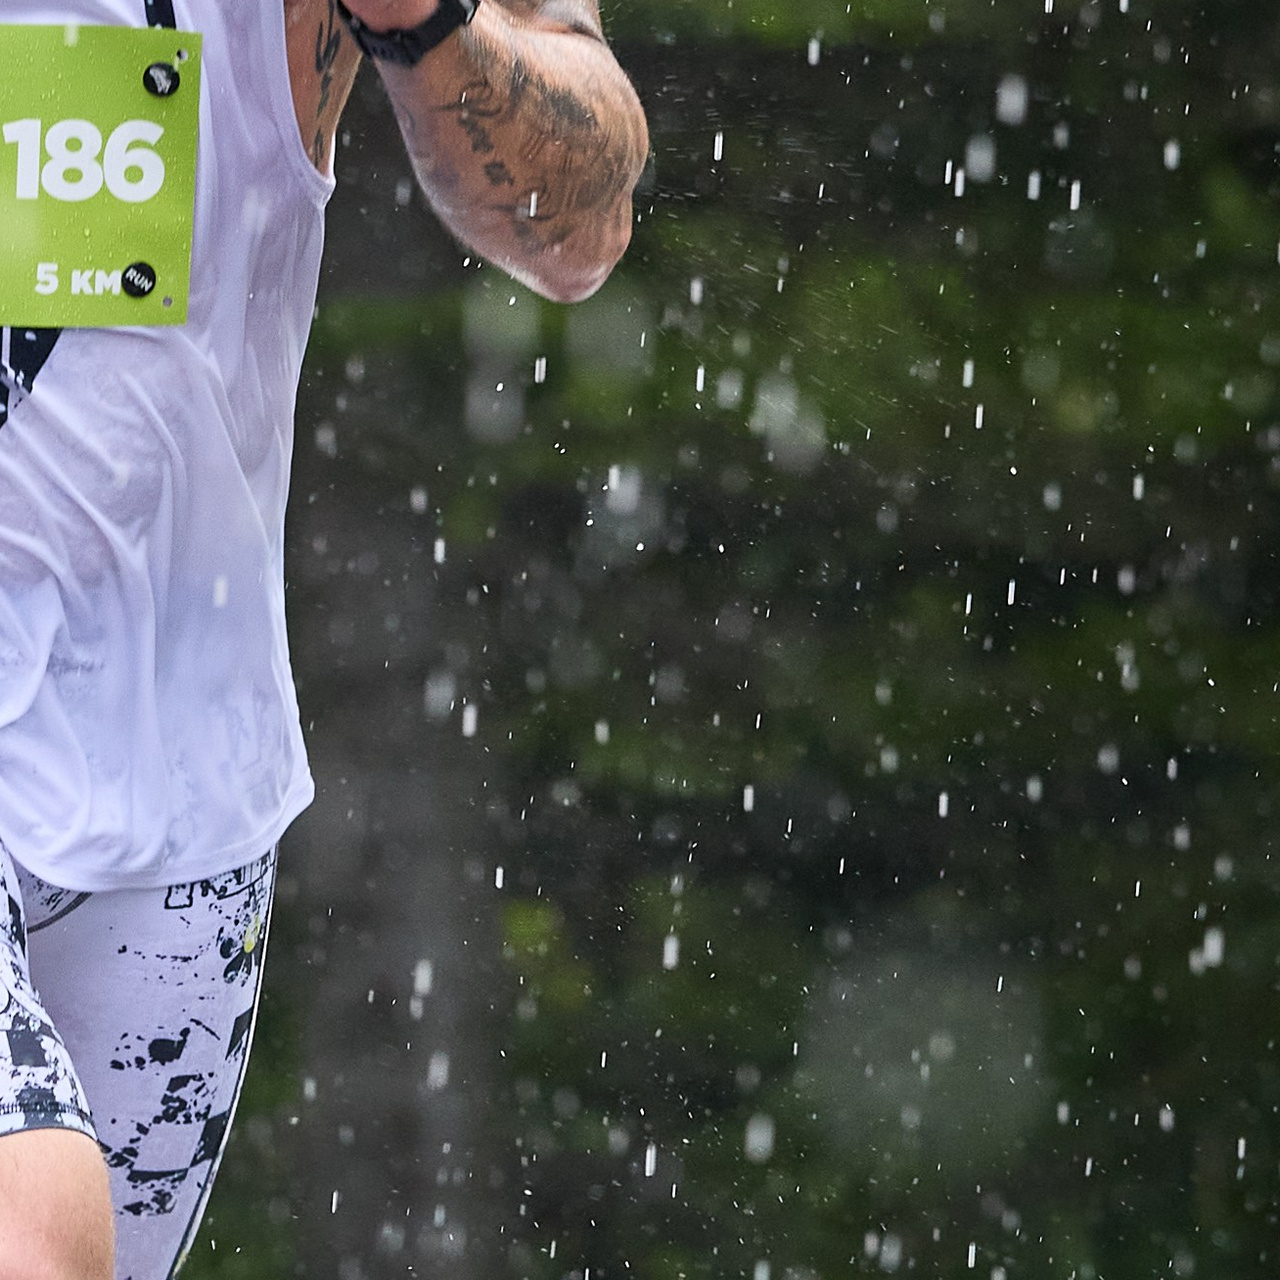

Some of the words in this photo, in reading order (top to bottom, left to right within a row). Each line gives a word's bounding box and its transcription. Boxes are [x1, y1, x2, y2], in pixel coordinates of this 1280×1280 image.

[2, 118, 165, 203] 186
[35, 261, 59, 296] 5
[125, 267, 153, 293] RUN
